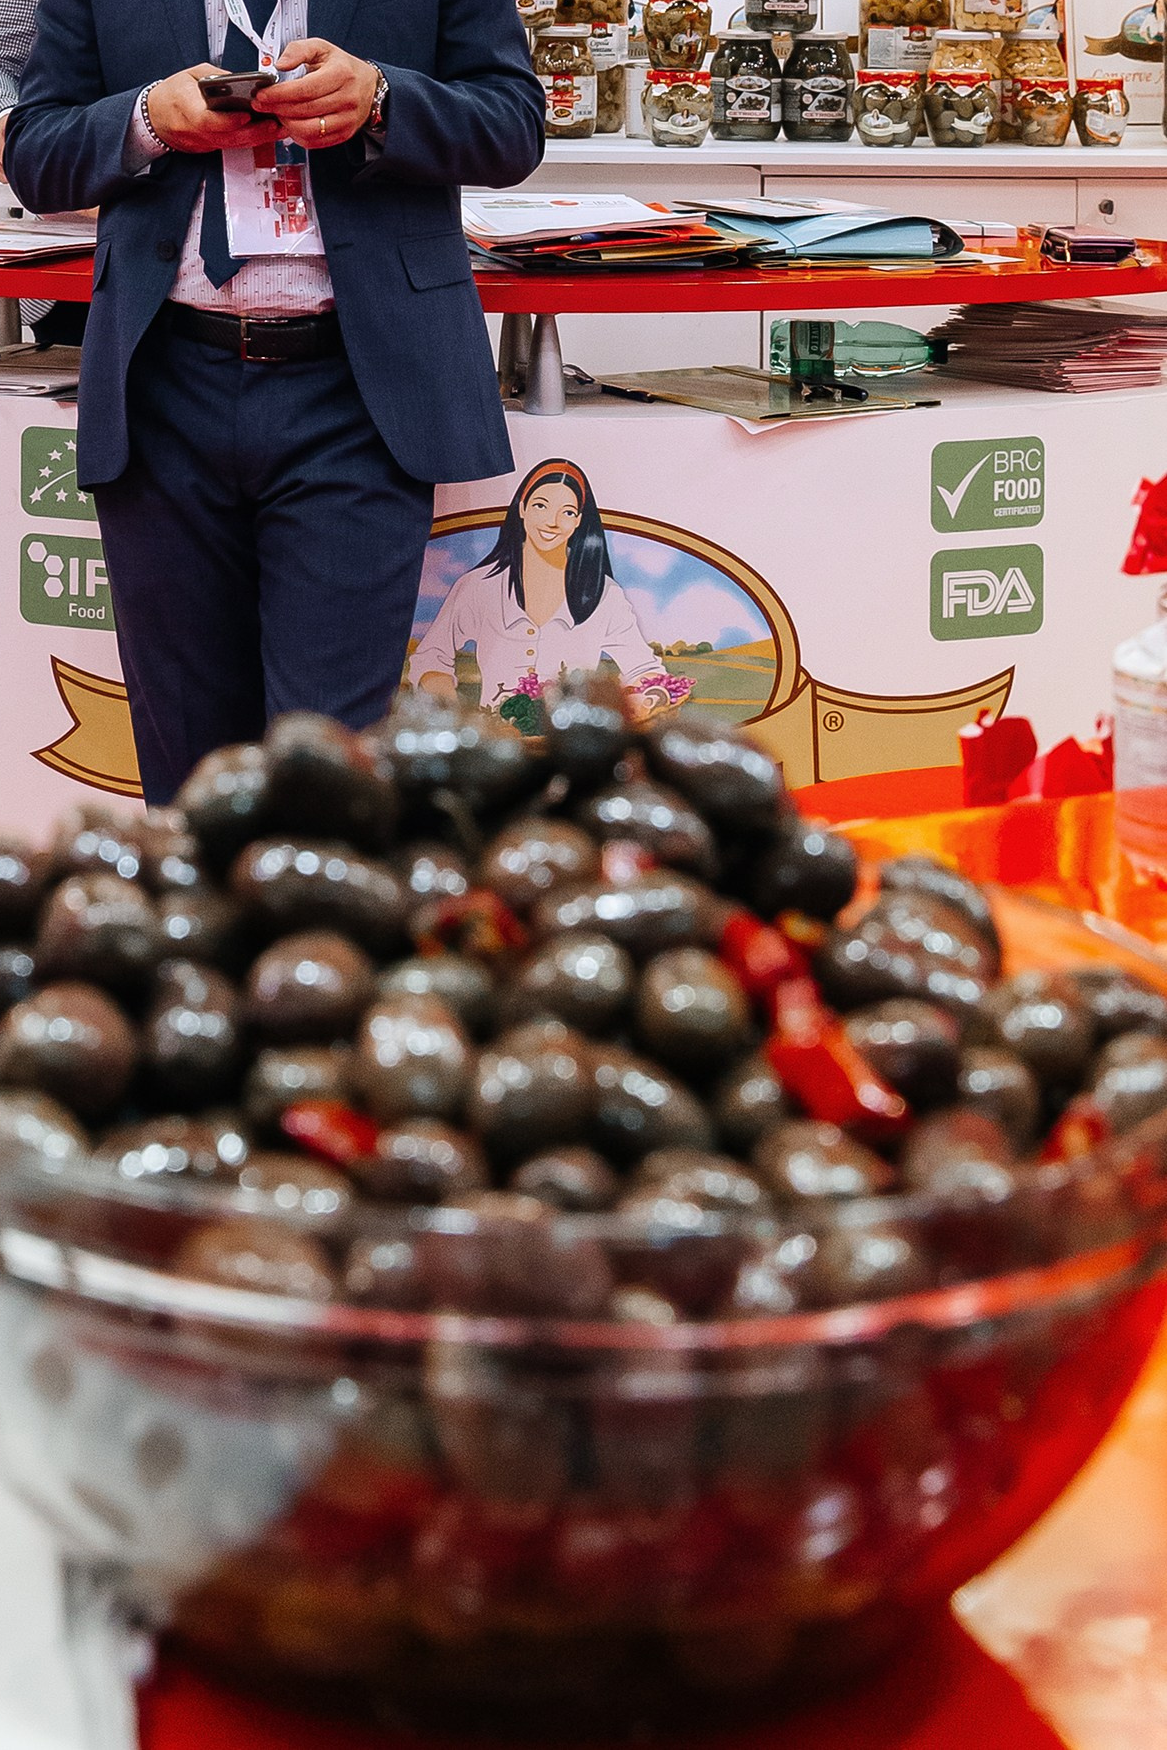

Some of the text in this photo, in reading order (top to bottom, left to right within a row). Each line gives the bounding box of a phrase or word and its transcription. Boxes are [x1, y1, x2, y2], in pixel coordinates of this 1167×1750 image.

[993, 448, 1042, 474] BRC
[993, 478, 1042, 502] FOOD
[993, 505, 1041, 517] CERTIFICATED
[69, 557, 109, 597] IF
[942, 567, 1036, 619] FDA
[68, 602, 105, 620] Food
